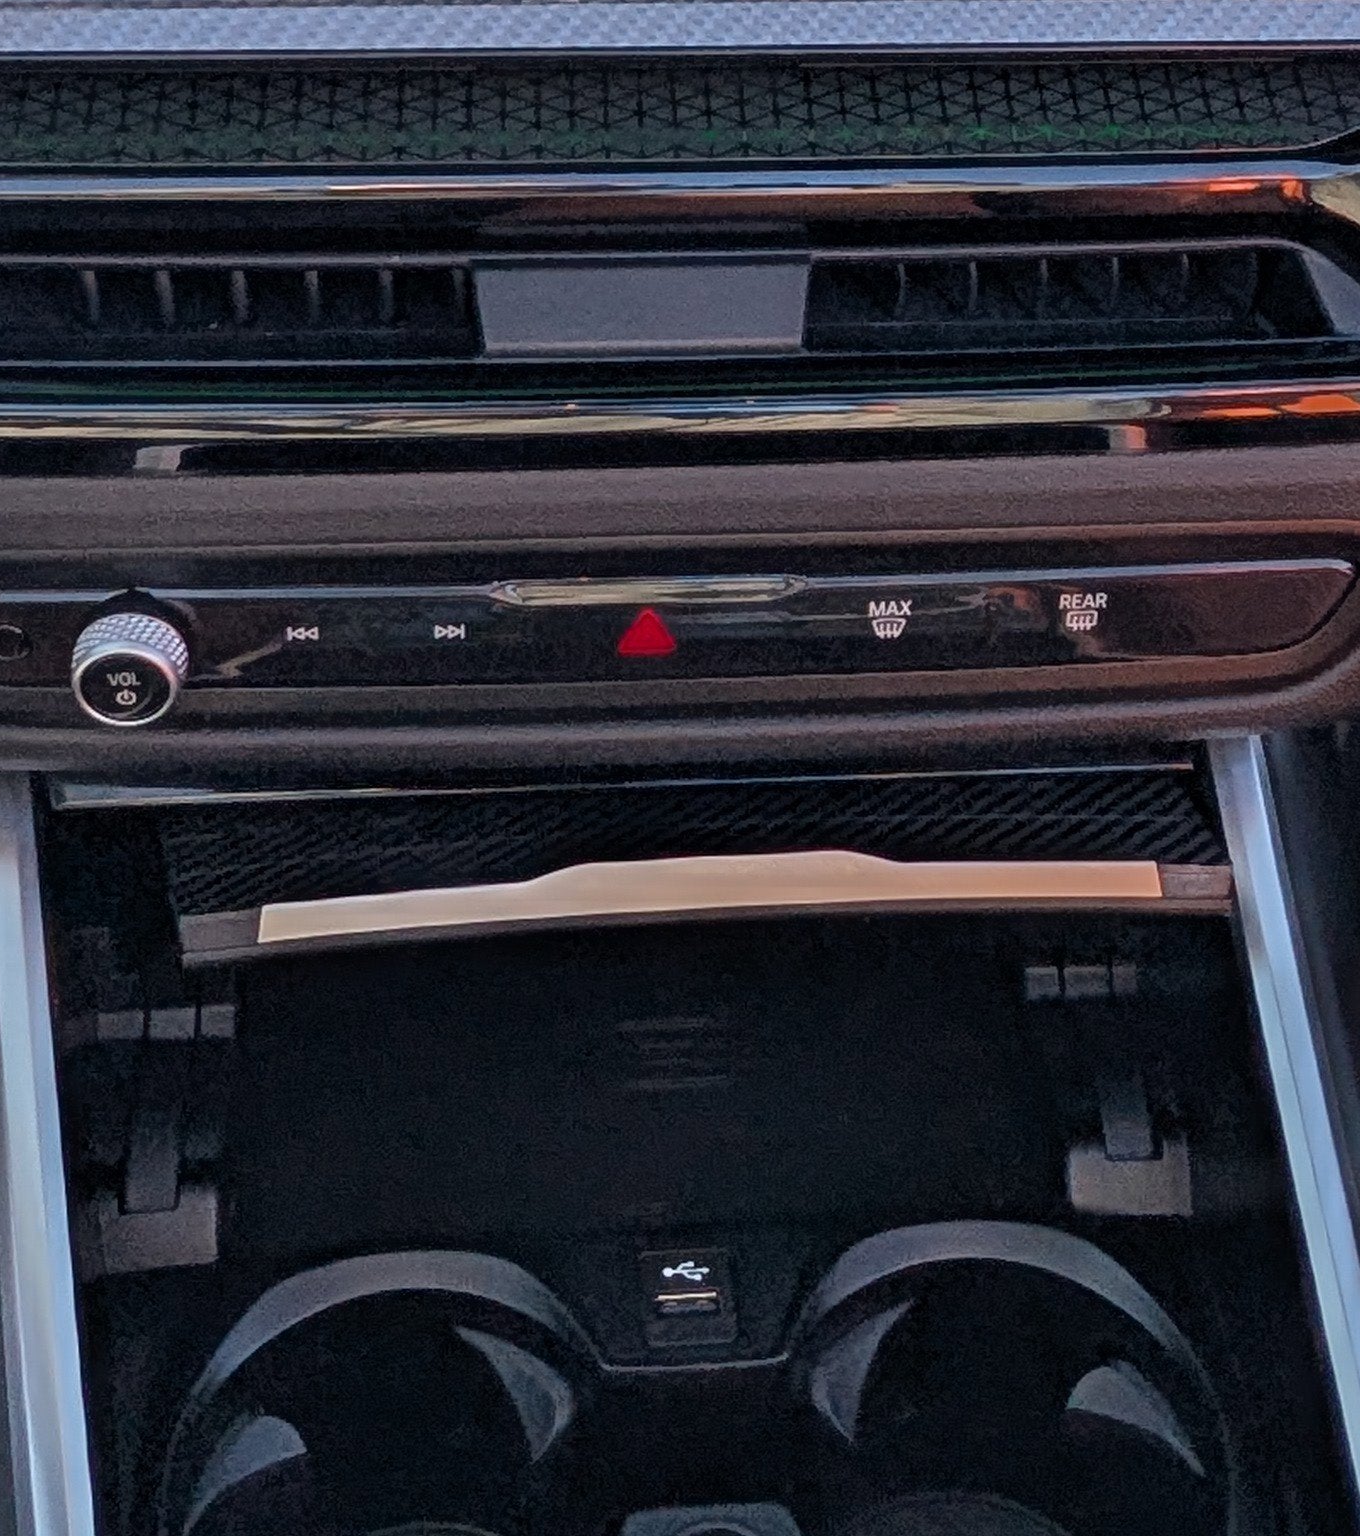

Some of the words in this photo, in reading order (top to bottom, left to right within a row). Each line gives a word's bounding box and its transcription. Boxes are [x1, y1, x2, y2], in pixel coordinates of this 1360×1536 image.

[869, 600, 912, 616] MAX
[1059, 593, 1108, 610] REAR
[106, 671, 142, 686] VOL
